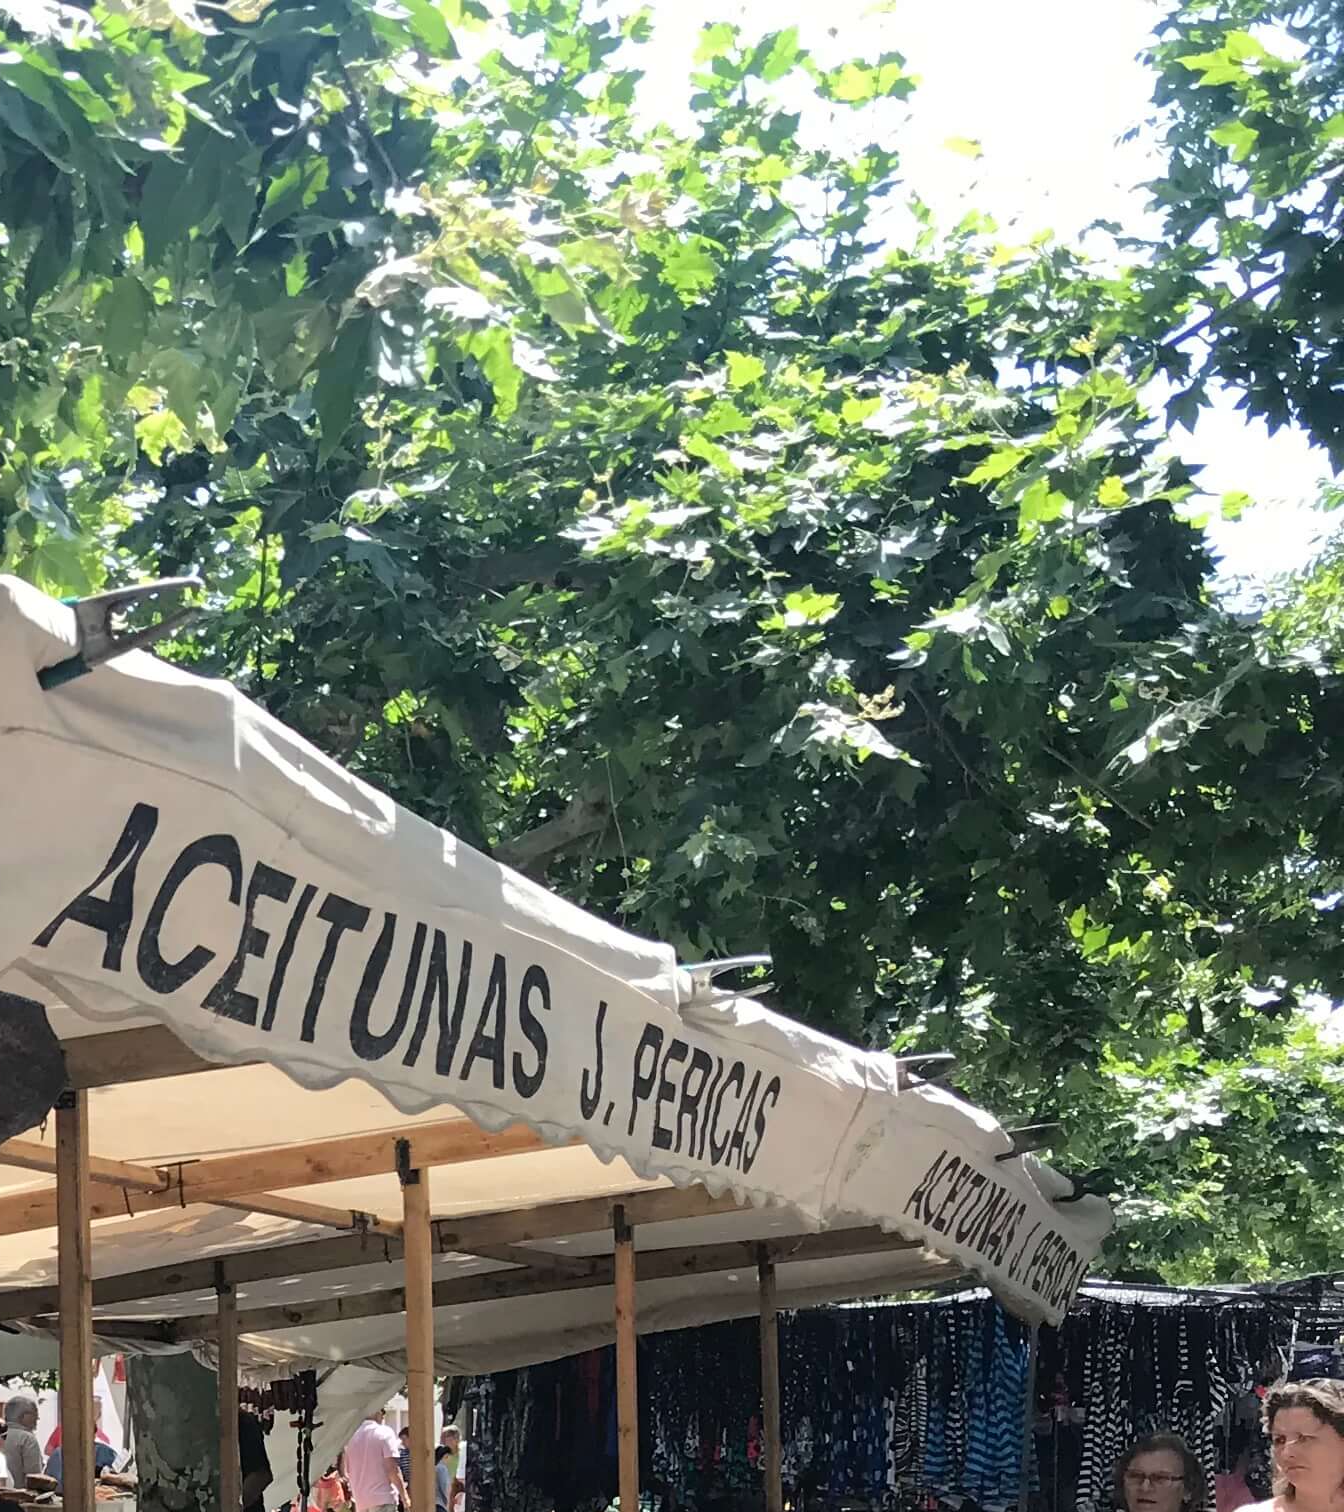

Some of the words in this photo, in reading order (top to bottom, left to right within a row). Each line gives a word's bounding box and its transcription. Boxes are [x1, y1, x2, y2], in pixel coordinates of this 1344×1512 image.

[32, 802, 551, 1098] ACEITUNAS
[580, 1000, 615, 1126] J.
[628, 1022, 781, 1174] PERICAS
[902, 1150, 1027, 1266] ACEITUNAS
[1008, 1221, 1042, 1281] J.
[1023, 1230, 1086, 1311] PERICA
